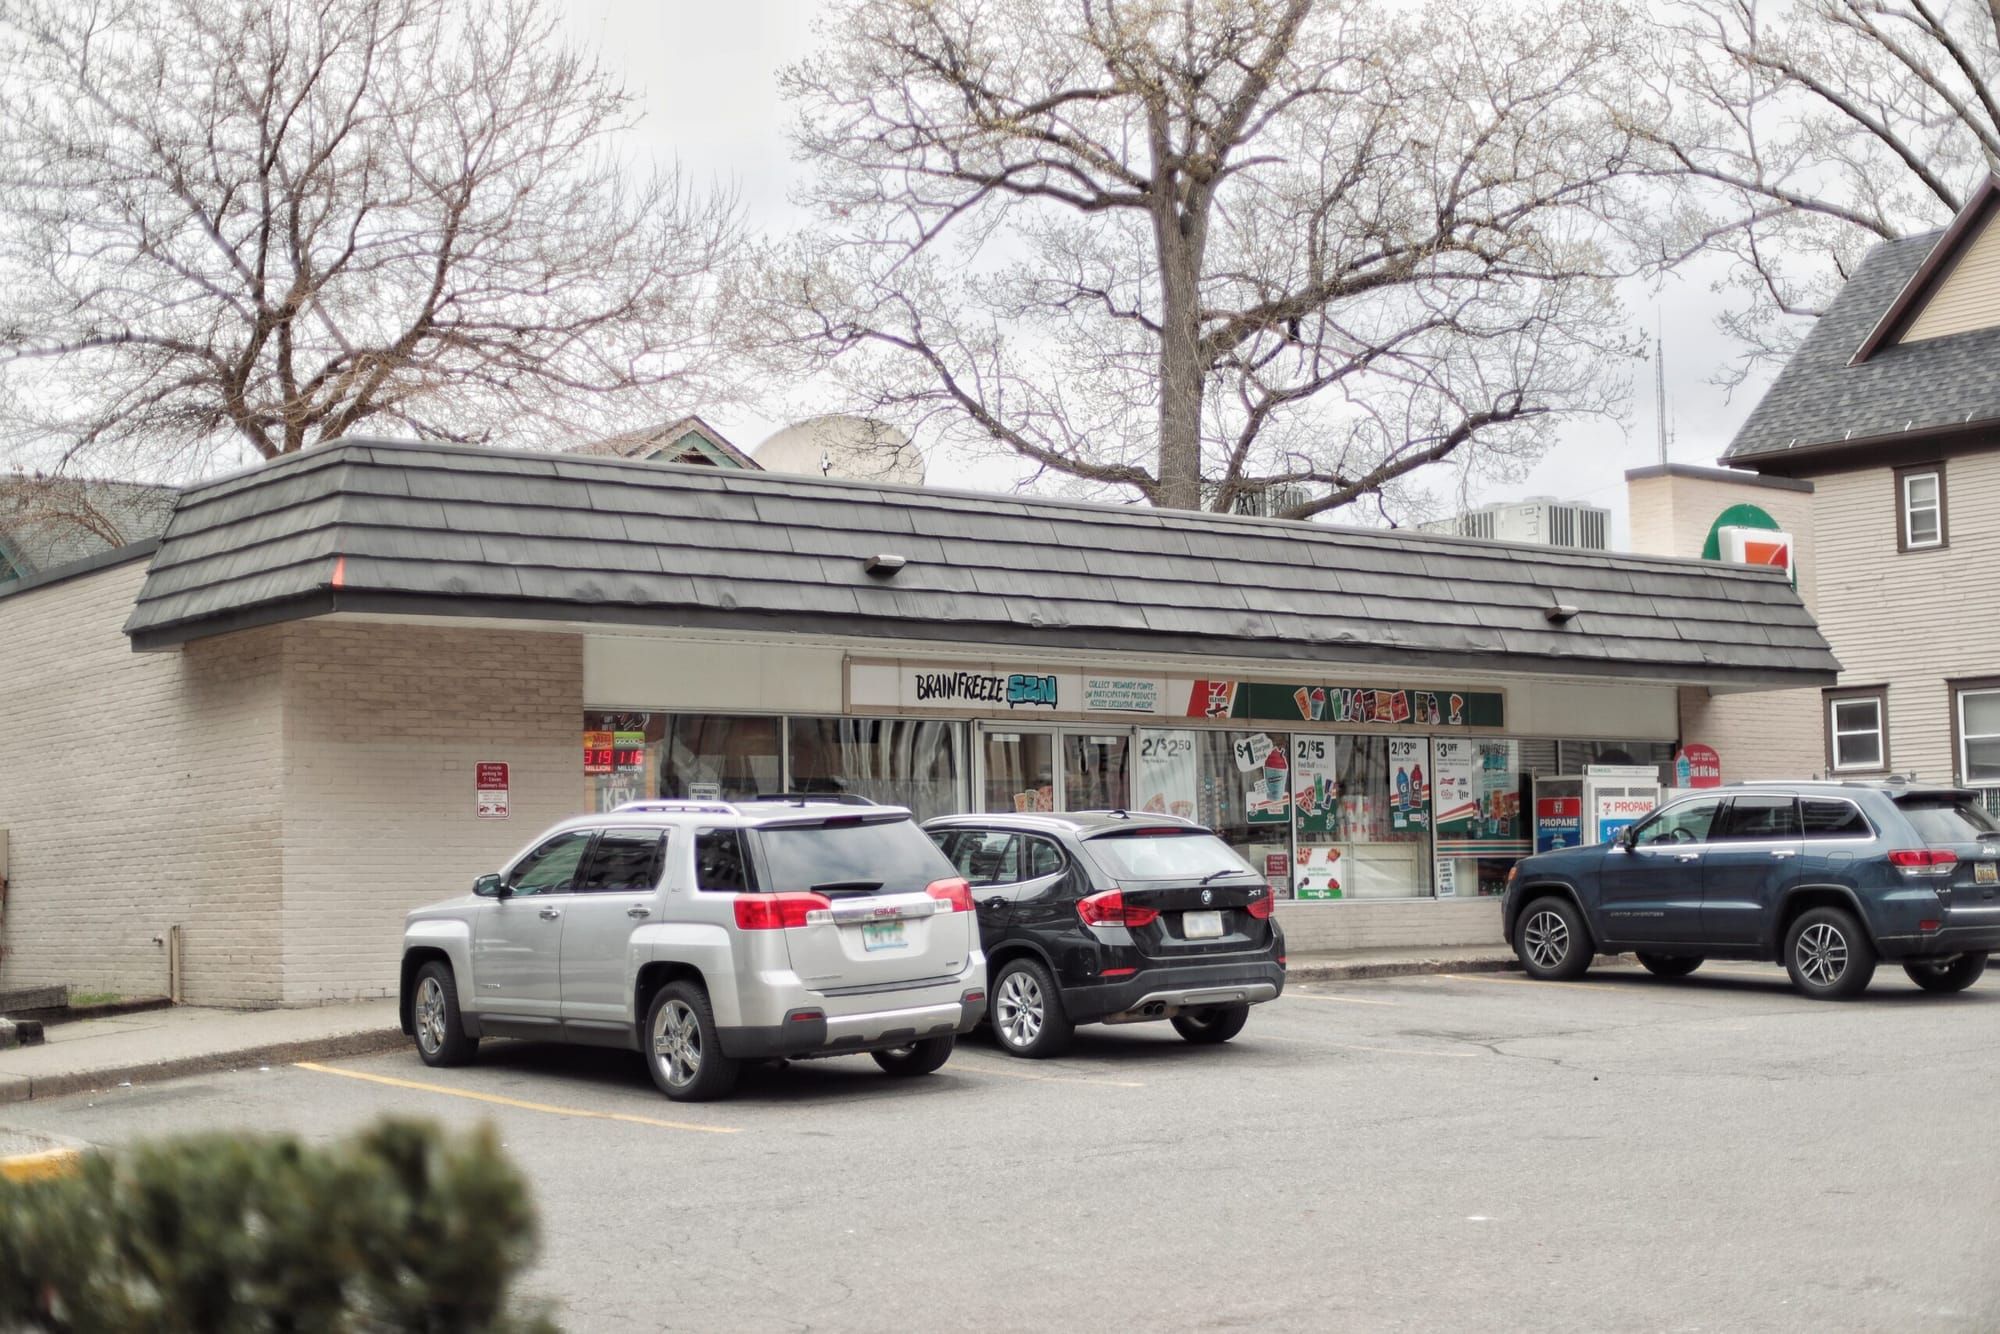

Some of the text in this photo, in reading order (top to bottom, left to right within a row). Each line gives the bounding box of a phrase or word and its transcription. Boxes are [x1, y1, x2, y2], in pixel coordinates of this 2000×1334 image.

[1447, 743, 1458, 752] OFF
[1236, 741, 1254, 765] $1
[1614, 802, 1653, 813] PROPANE
[1539, 818, 1578, 827] PROPANE
[1248, 889, 1261, 897] X1
